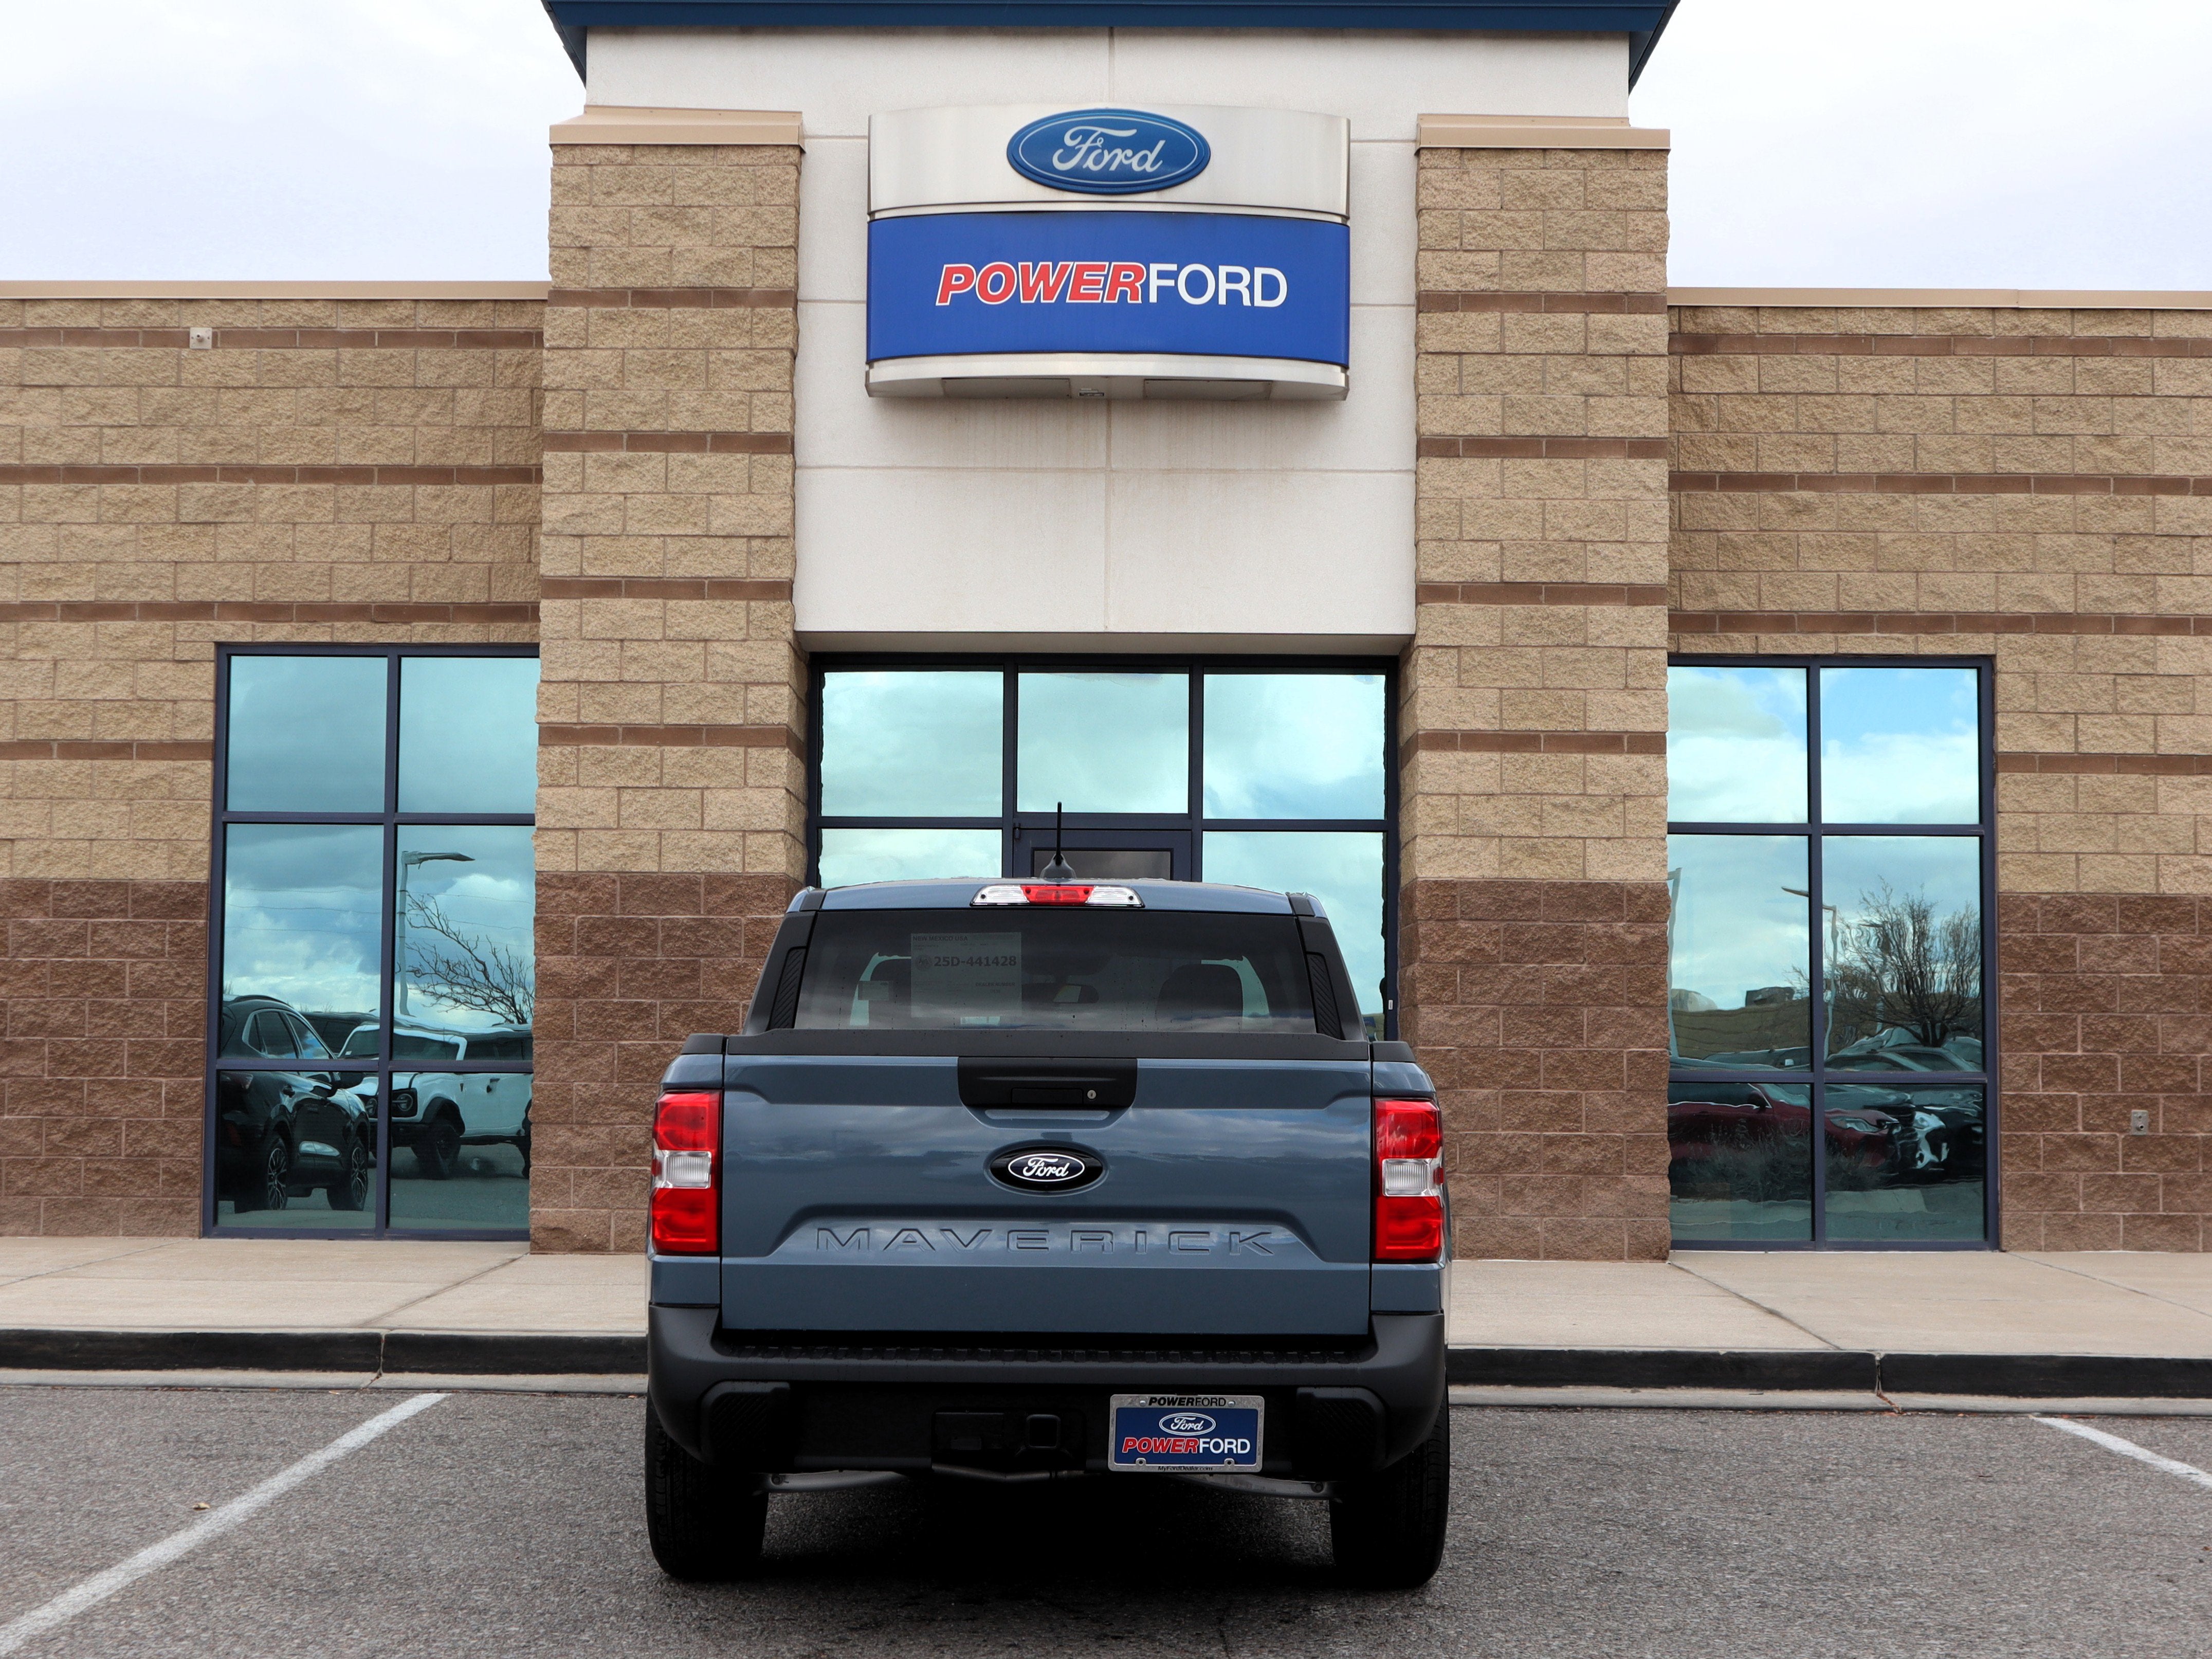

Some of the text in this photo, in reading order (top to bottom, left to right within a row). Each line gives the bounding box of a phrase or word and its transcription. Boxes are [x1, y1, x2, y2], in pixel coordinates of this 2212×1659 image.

[1052, 125, 1166, 173] Ford
[934, 956, 1017, 967] 25D-441428
[1022, 1157, 1070, 1177] Ford
[816, 1227, 1275, 1256] MAVERICK
[1171, 1416, 1204, 1431] Ford
